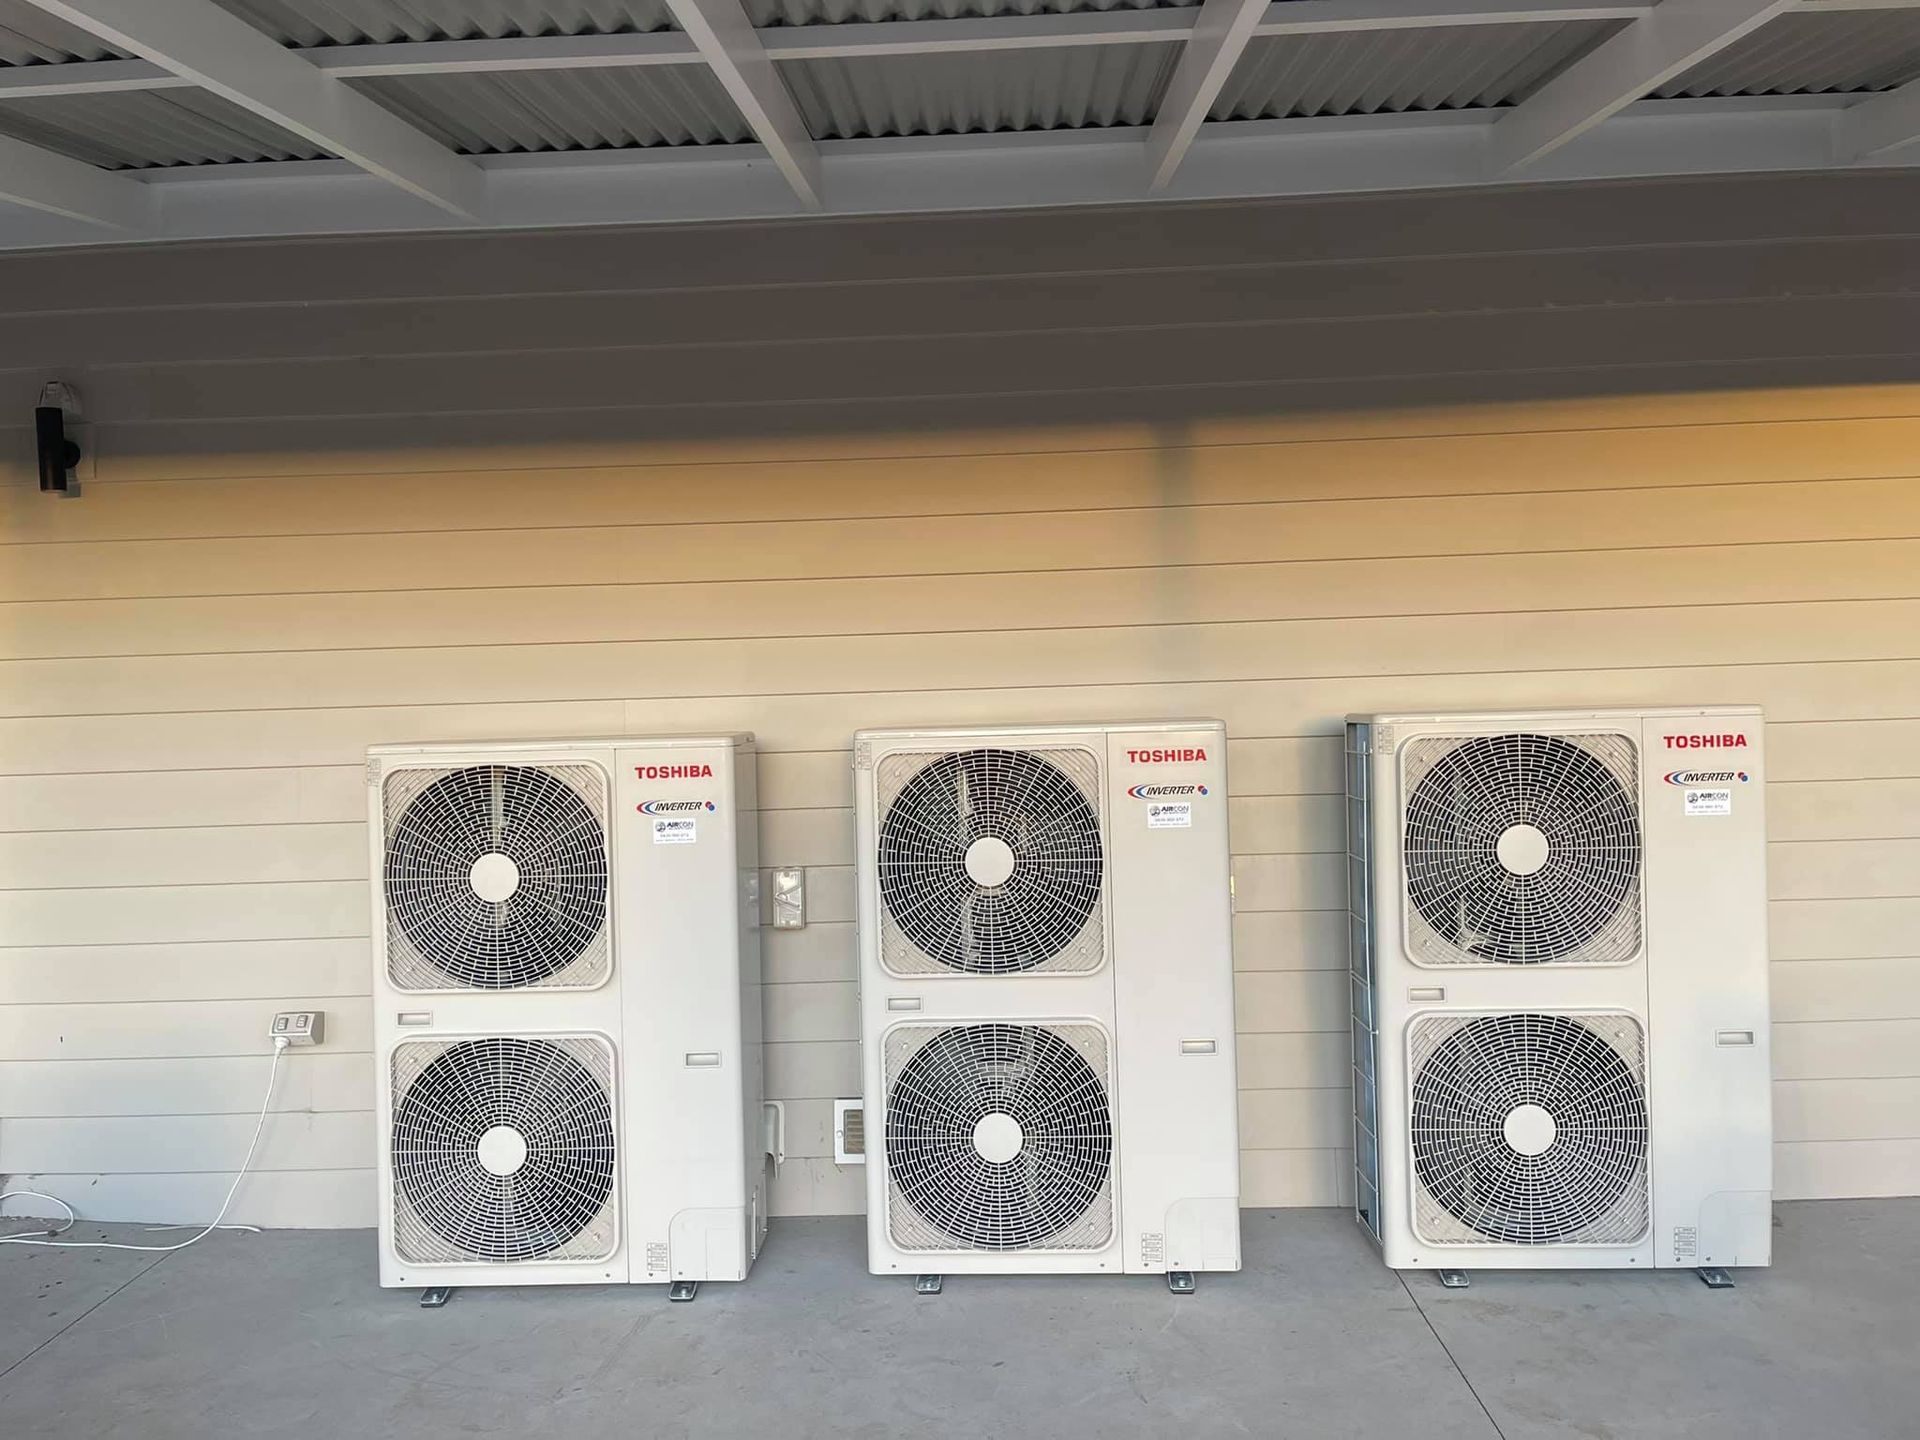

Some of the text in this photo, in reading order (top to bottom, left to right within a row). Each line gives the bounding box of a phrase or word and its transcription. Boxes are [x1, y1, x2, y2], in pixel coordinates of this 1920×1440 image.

[1663, 734, 1747, 749] TOSHIBA
[1127, 748, 1207, 763] TOSHIBA
[634, 764, 713, 779] TOSHIBA
[1683, 772, 1735, 782] INVERTER
[1146, 785, 1195, 795] INVERTER
[654, 801, 702, 811] INVERTER
